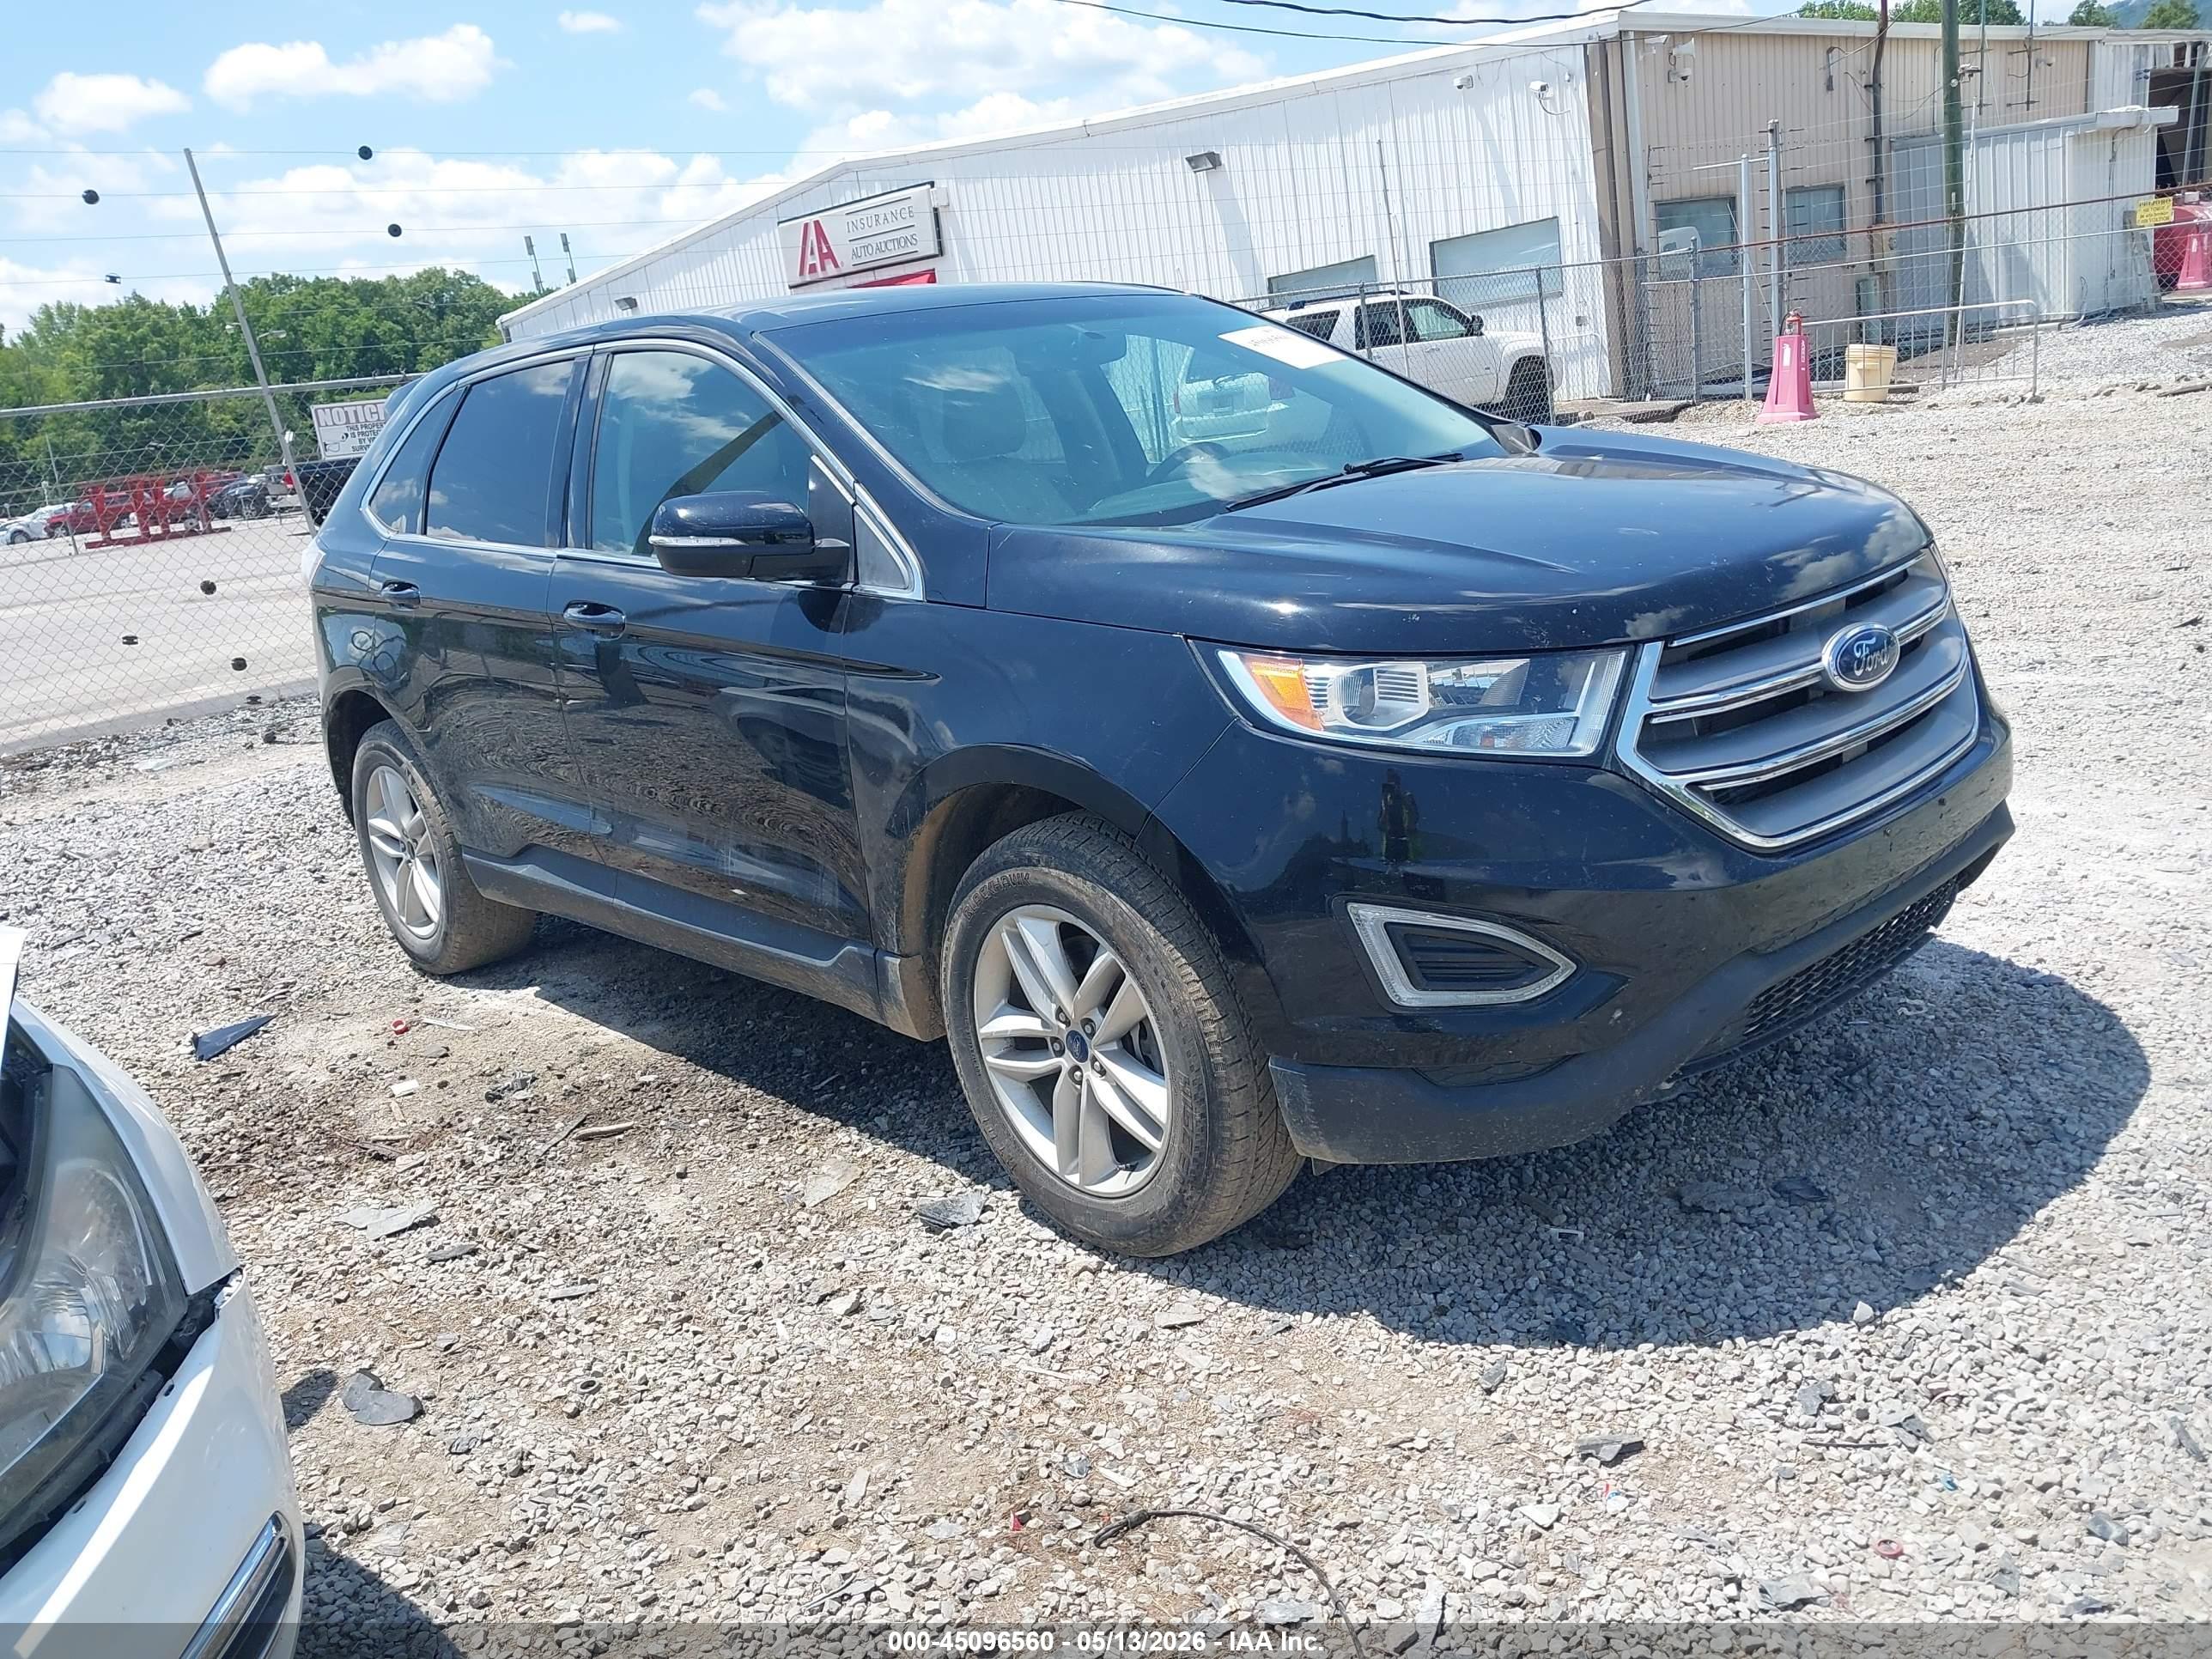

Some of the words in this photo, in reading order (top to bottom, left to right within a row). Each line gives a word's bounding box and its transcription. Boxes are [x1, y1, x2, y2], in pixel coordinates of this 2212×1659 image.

[846, 205, 915, 234] INSURANCE
[851, 241, 875, 260] AUTO
[874, 233, 919, 258] AUCTIONS
[1853, 636, 1890, 677] Ford
